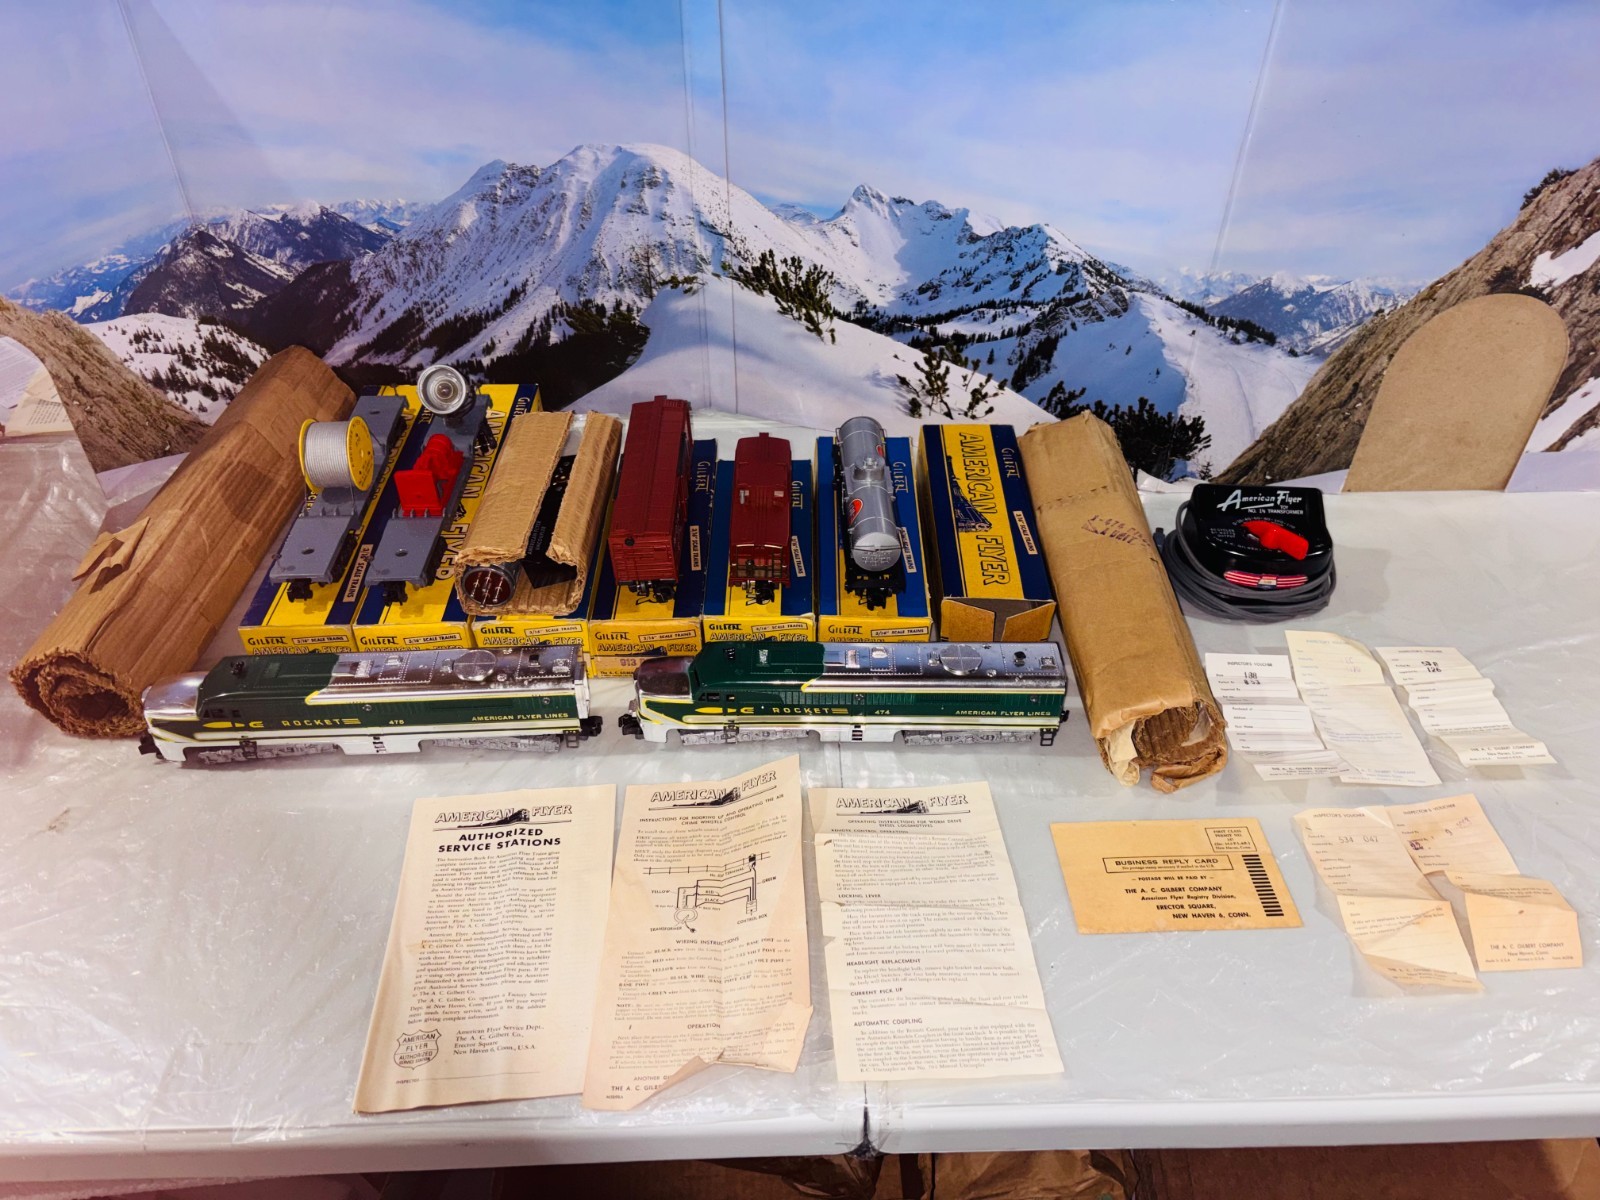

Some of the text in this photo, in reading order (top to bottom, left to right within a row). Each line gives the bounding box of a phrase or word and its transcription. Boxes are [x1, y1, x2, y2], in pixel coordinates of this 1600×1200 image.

[1001, 447, 1021, 479] GILBERT
[893, 461, 909, 493] GILBERT
[1216, 489, 1302, 511] American Flyer
[959, 432, 1011, 586] AMERICAN FLYER
[1020, 525, 1035, 553] SCALE TRAINS
[347, 562, 365, 598] SCALE TRAINS
[481, 626, 515, 635] GILBERT
[708, 623, 743, 631] GILBERT
[828, 625, 863, 635] GILBERT
[248, 636, 286, 646] GILBERT
[360, 636, 398, 646] GILBERT
[595, 632, 632, 641] GILBERT
[710, 633, 808, 642] AMERICAN FLYER
[483, 637, 583, 646] AMERICAN FLYER
[253, 646, 309, 655] AMERICAN
[597, 643, 698, 652] AMERICAN FLYER
[620, 658, 637, 667] 913
[772, 706, 831, 714] ROCKET
[281, 718, 341, 727] ROCKET
[650, 770, 777, 803] AMERICAN FLYER
[835, 793, 969, 809] AMERICAN FLYER
[737, 800, 764, 813] OPERATING
[434, 804, 573, 824] AMERICAN FLYER
[724, 812, 747, 823] CONTROL
[458, 827, 543, 842] AUTHORIZED
[438, 837, 561, 853] SERVICE STATIONS
[737, 917, 758, 925] CONTROL
[700, 936, 740, 945] INSTRUCTIONS
[846, 959, 879, 967] HEADLIGHT
[456, 1028, 485, 1036] American
[488, 1032, 509, 1040] Gilbert
[402, 1033, 436, 1044] AMERICAN
[405, 1043, 428, 1052] FLYER
[478, 1040, 498, 1048] Square
[399, 1051, 433, 1060] AUTHORIZED
